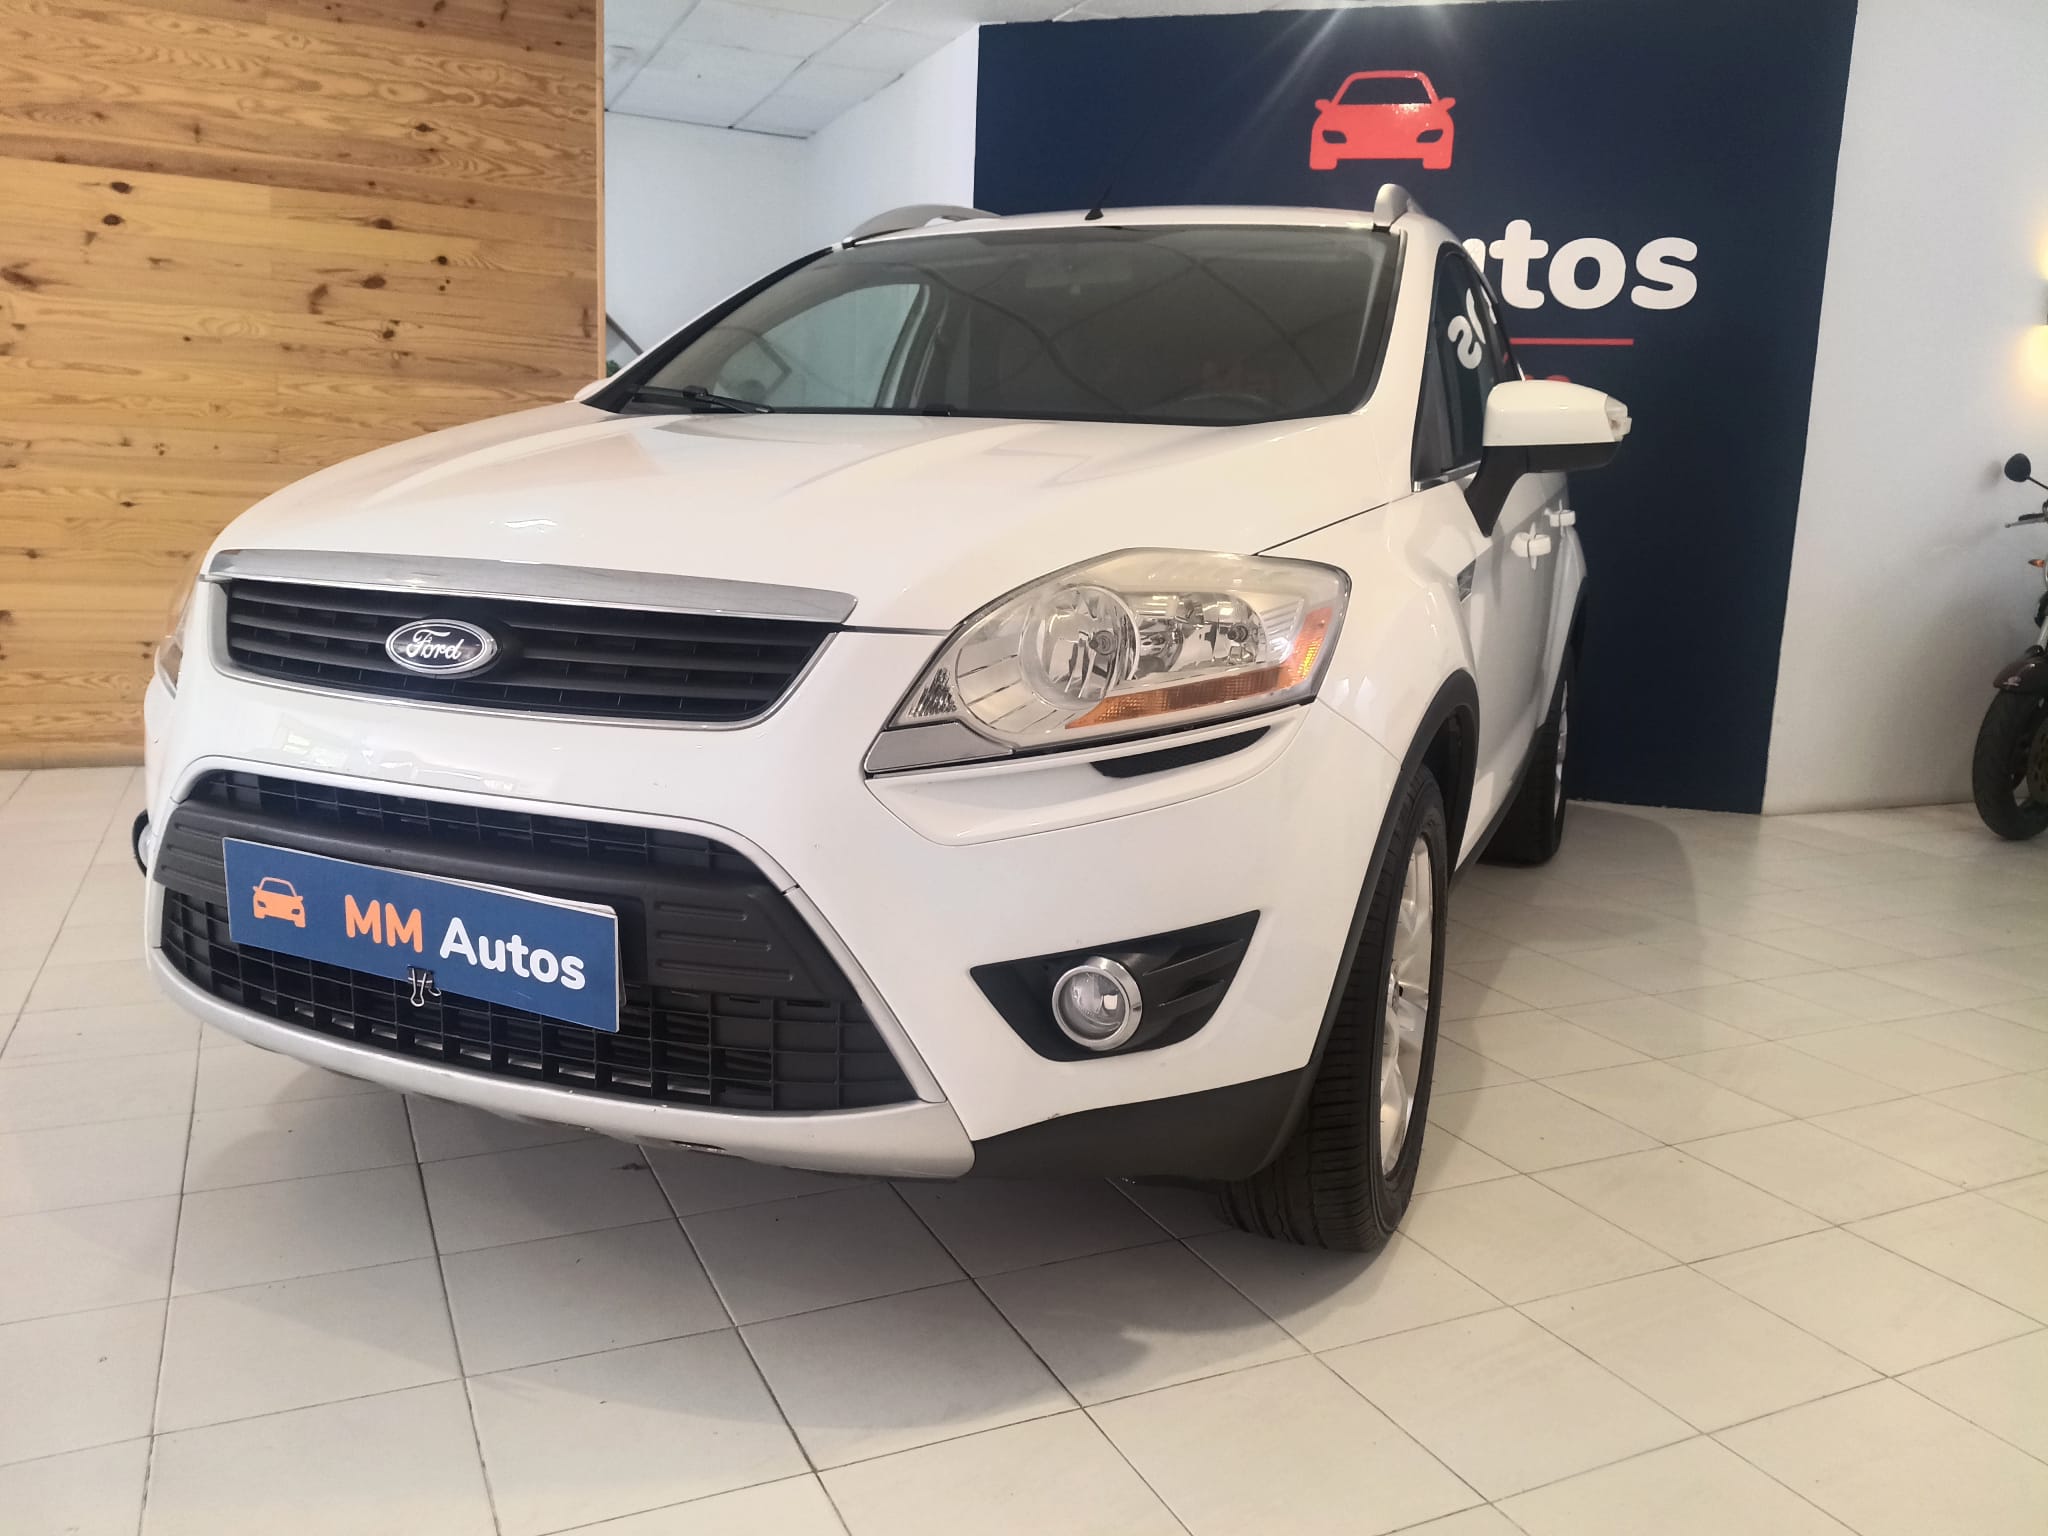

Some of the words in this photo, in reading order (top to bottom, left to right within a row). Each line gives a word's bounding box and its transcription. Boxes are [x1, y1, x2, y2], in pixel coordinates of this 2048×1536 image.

[1462, 219, 1698, 309] tos
[406, 629, 464, 660] Ford
[345, 894, 422, 953] MM
[440, 917, 585, 990] Autos
